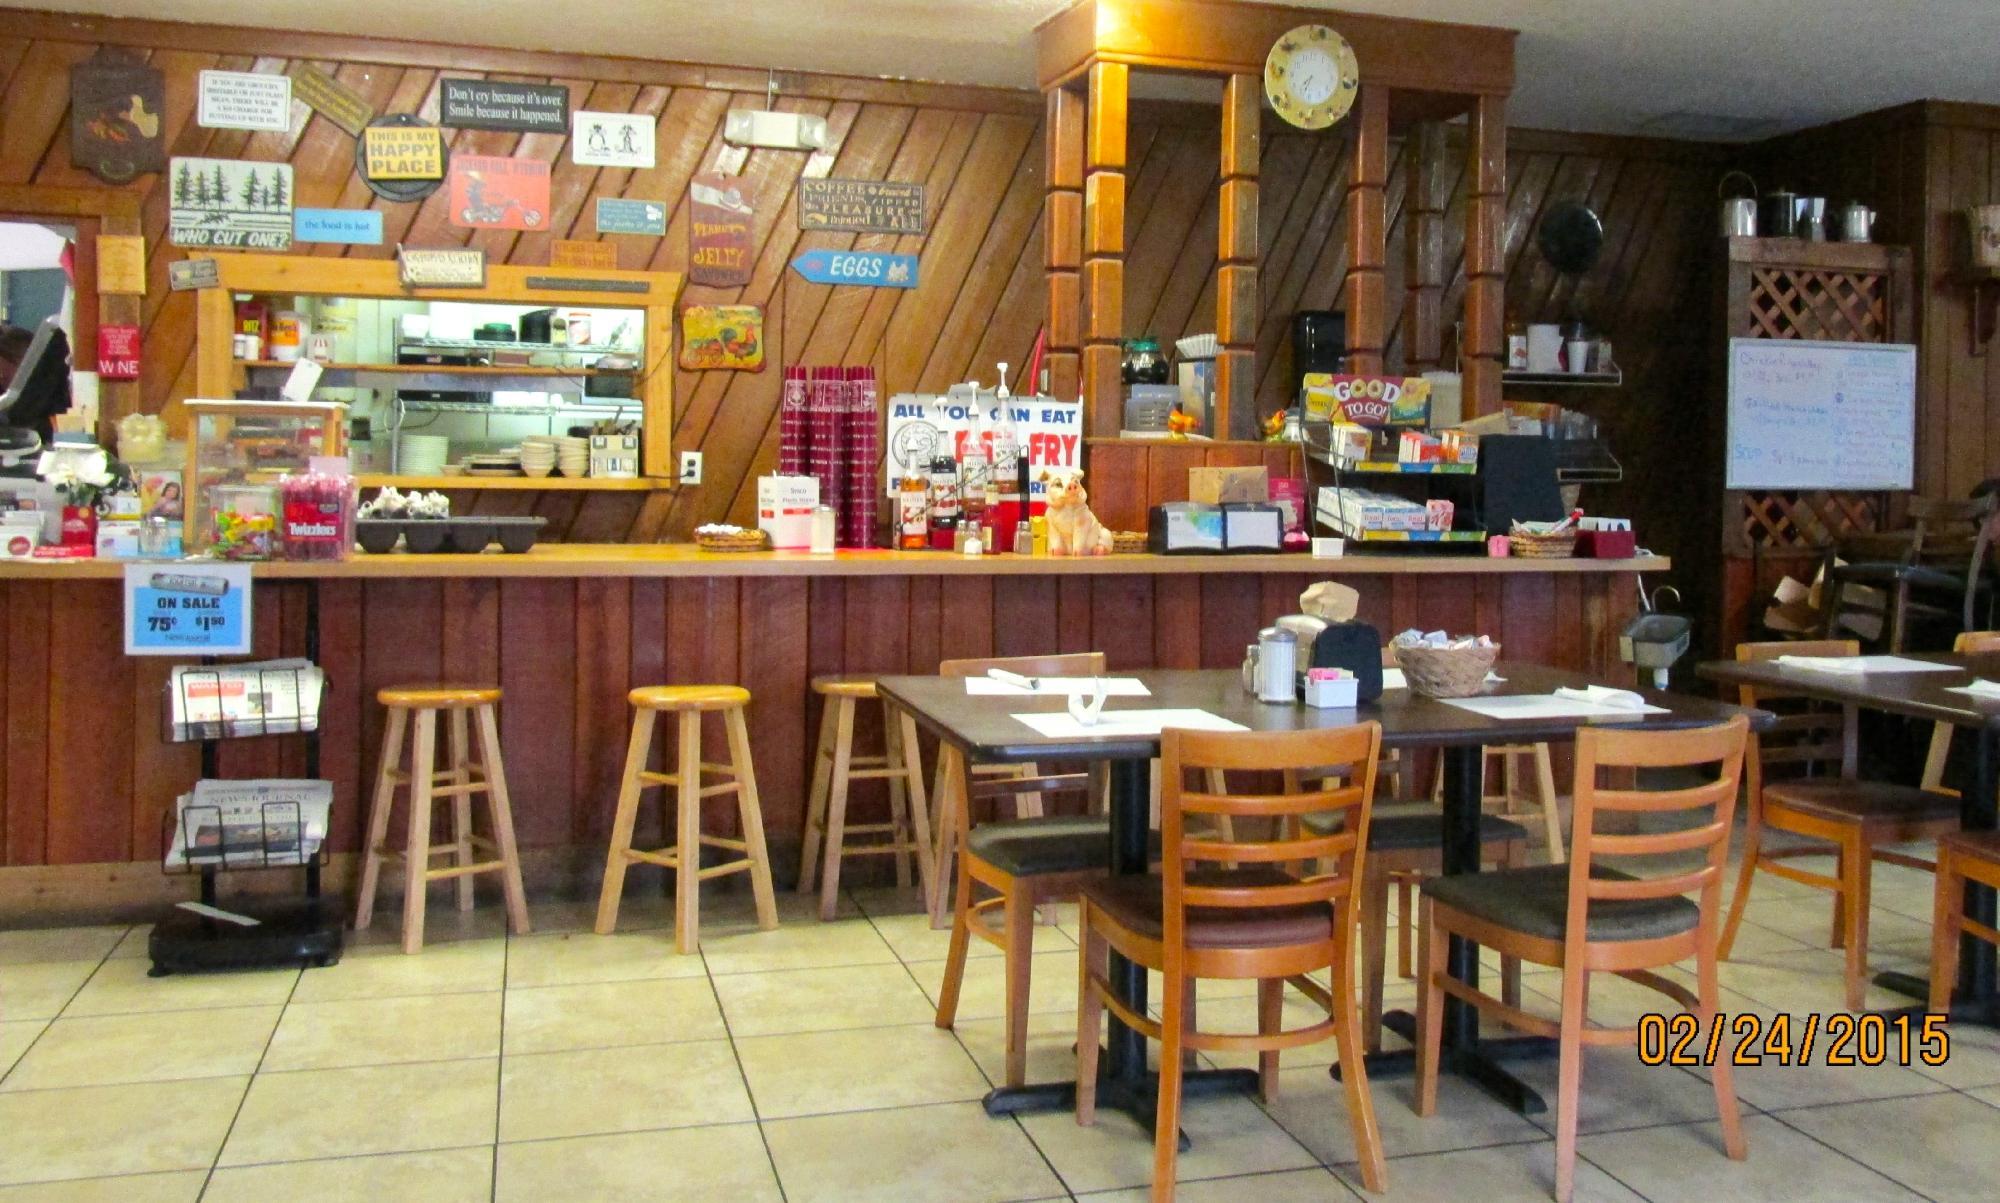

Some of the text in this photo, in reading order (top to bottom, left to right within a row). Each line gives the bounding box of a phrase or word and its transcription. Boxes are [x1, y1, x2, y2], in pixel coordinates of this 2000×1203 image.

[449, 87, 474, 101] Don't
[476, 91, 489, 105] cry
[492, 90, 525, 105] because
[527, 91, 541, 105] it's
[449, 102, 474, 117] Smile
[476, 104, 510, 119] because
[512, 106, 519, 120] it
[371, 131, 434, 142] THIS IS MY
[370, 143, 435, 157] HAPPY
[372, 159, 436, 174] PLACE
[304, 219, 318, 229] the
[321, 219, 342, 231] food
[173, 228, 290, 250] WHO CUT ONE?
[693, 247, 745, 268] JELLY
[830, 254, 882, 278] EGGS
[99, 360, 140, 375] WNE
[1334, 379, 1401, 403] GOOD
[893, 404, 925, 419] ALL
[1042, 409, 1077, 425] EAT
[1345, 402, 1363, 417] TO
[1365, 402, 1387, 418] GO!
[1029, 431, 1079, 468] FRY
[288, 521, 337, 537] Twizzlers
[157, 597, 221, 609] ON SALE
